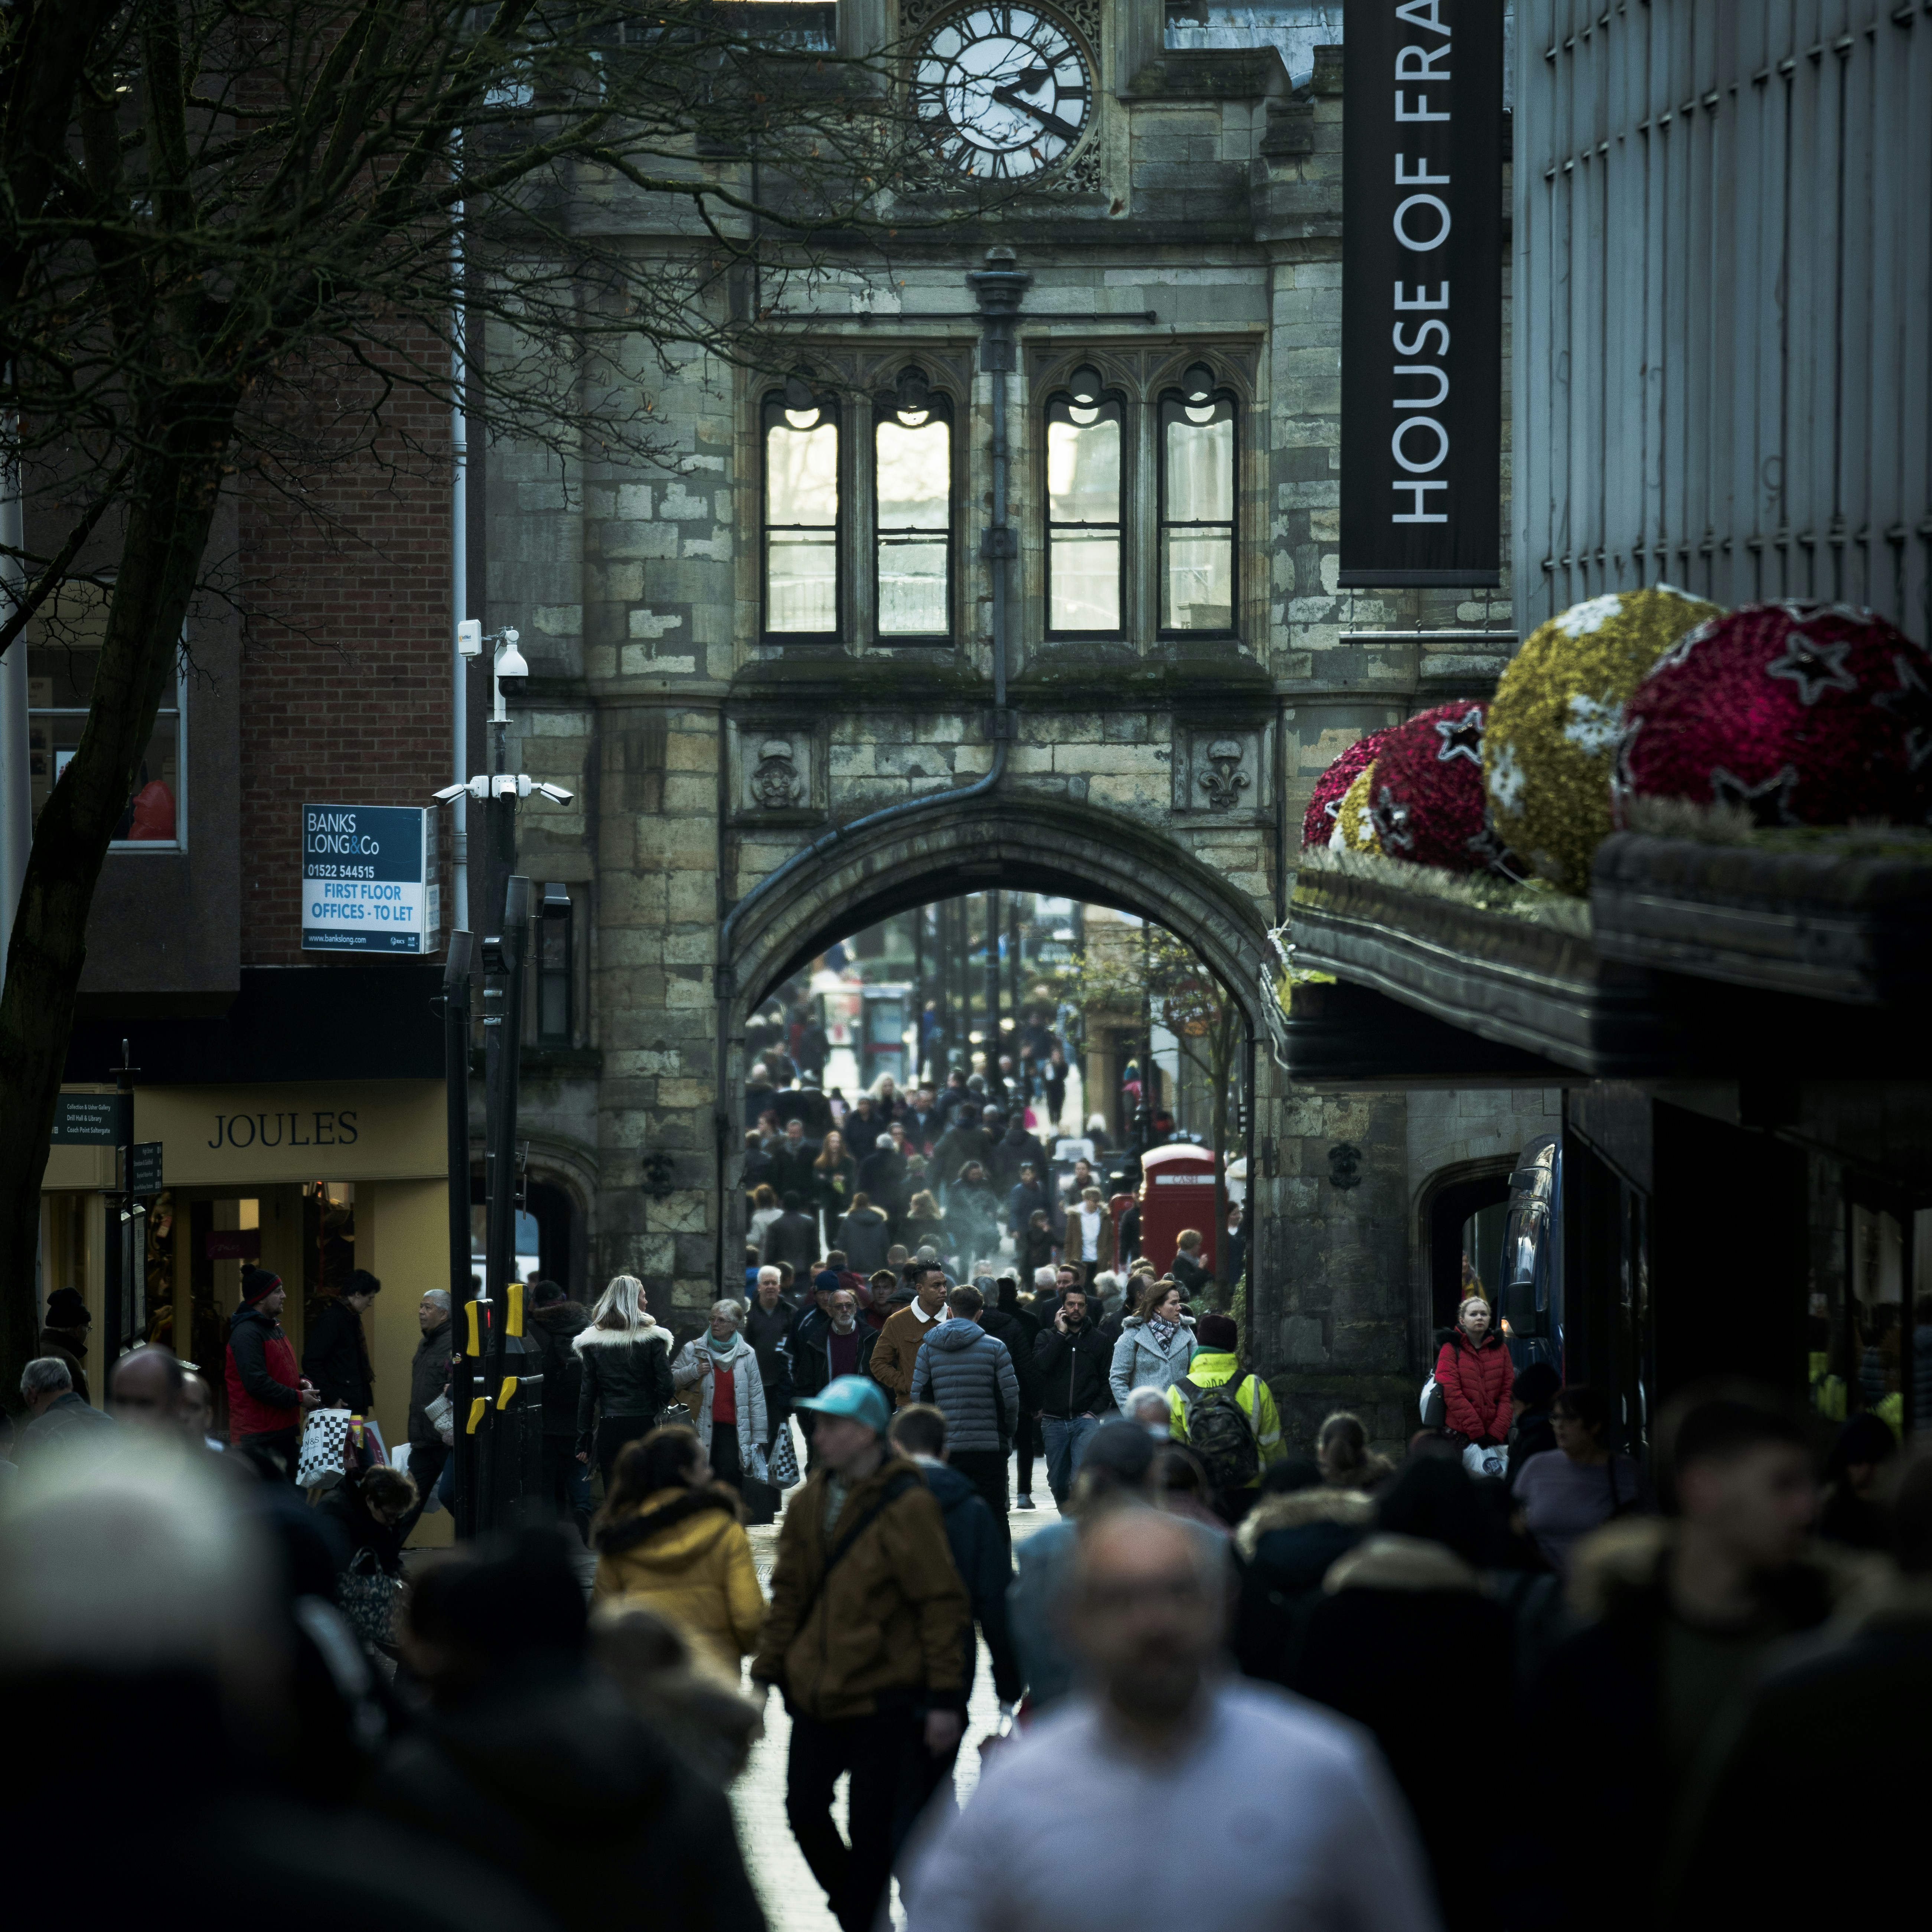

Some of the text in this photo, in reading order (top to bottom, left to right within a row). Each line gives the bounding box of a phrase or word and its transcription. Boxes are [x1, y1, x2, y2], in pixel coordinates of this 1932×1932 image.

[1391, 0, 1452, 523] HOUSE OF FRA
[307, 813, 356, 833] BANKS
[307, 835, 379, 855] LONG&Co
[308, 864, 374, 878] 01522 544515
[324, 883, 401, 900] FIRST FLOOR
[311, 903, 364, 919] OFFICES
[373, 905, 390, 920] TO
[393, 906, 413, 921] LET
[308, 934, 366, 945] www.bankslong.com
[88, 1115, 102, 1123] Library
[91, 1127, 110, 1135] Saltergate
[208, 1111, 358, 1149] JOULES
[1172, 1175, 1198, 1184] CASH
[305, 1436, 319, 1448] M&S
